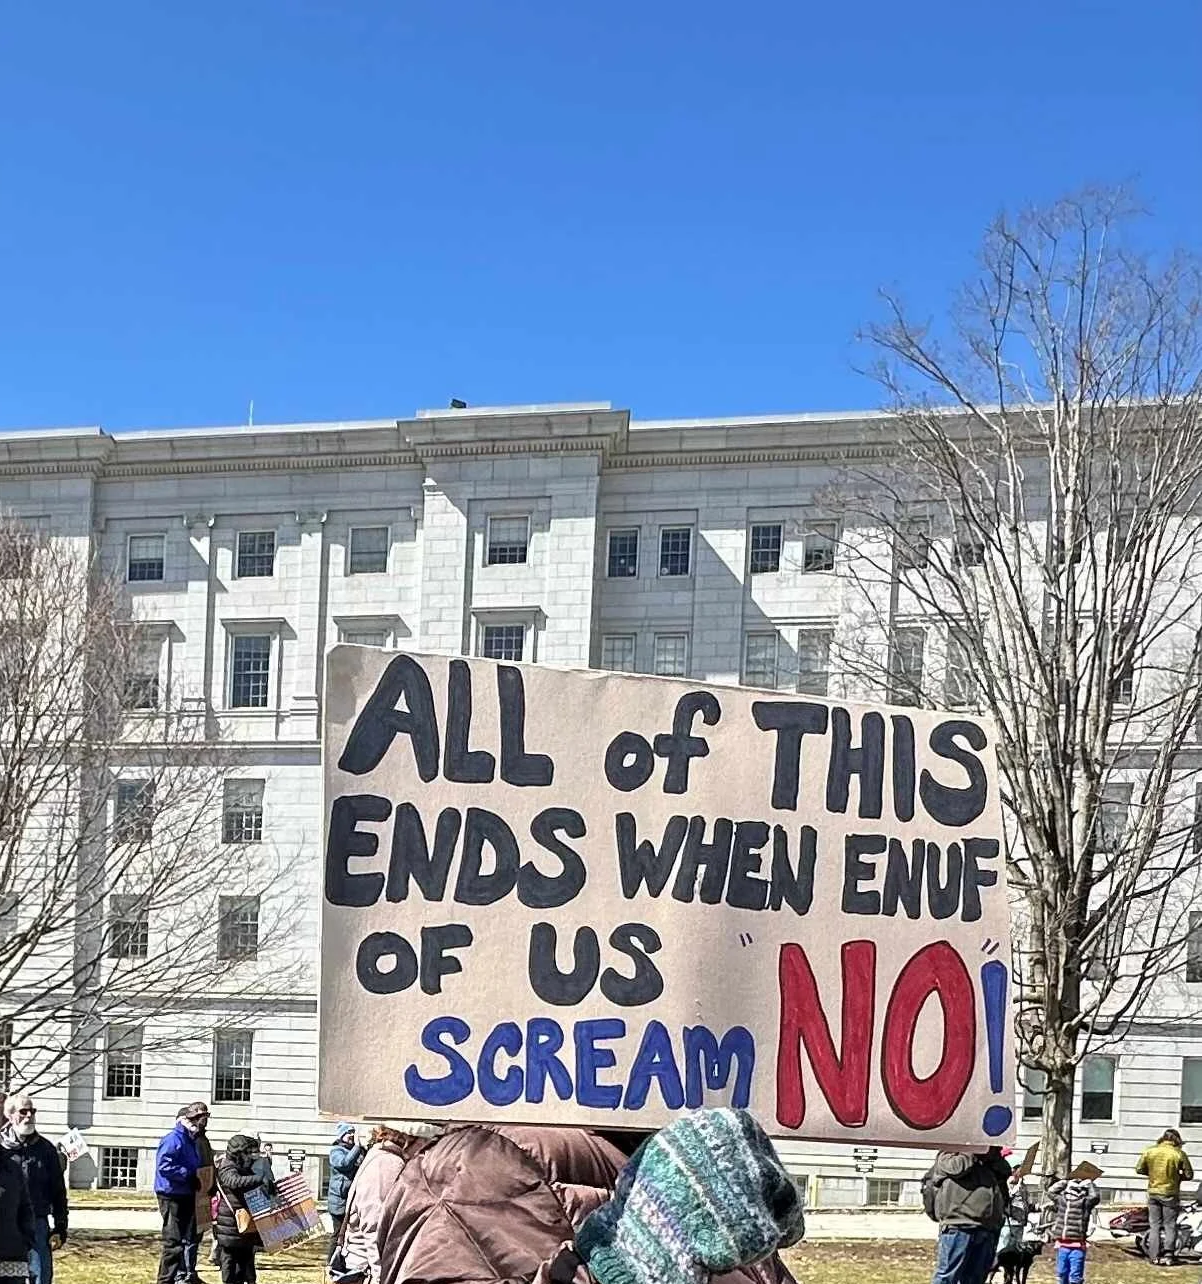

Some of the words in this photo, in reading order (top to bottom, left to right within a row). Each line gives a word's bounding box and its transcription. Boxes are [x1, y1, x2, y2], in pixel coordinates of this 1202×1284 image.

[338, 653, 554, 787] ALL
[605, 691, 721, 794] of
[753, 700, 988, 826] THIS
[325, 794, 587, 908] ENDS
[616, 811, 817, 916] WHEN
[842, 833, 999, 922] ENUF
[356, 923, 474, 996] OF
[528, 921, 664, 1006] US
[405, 1016, 756, 1110] SCREAM
